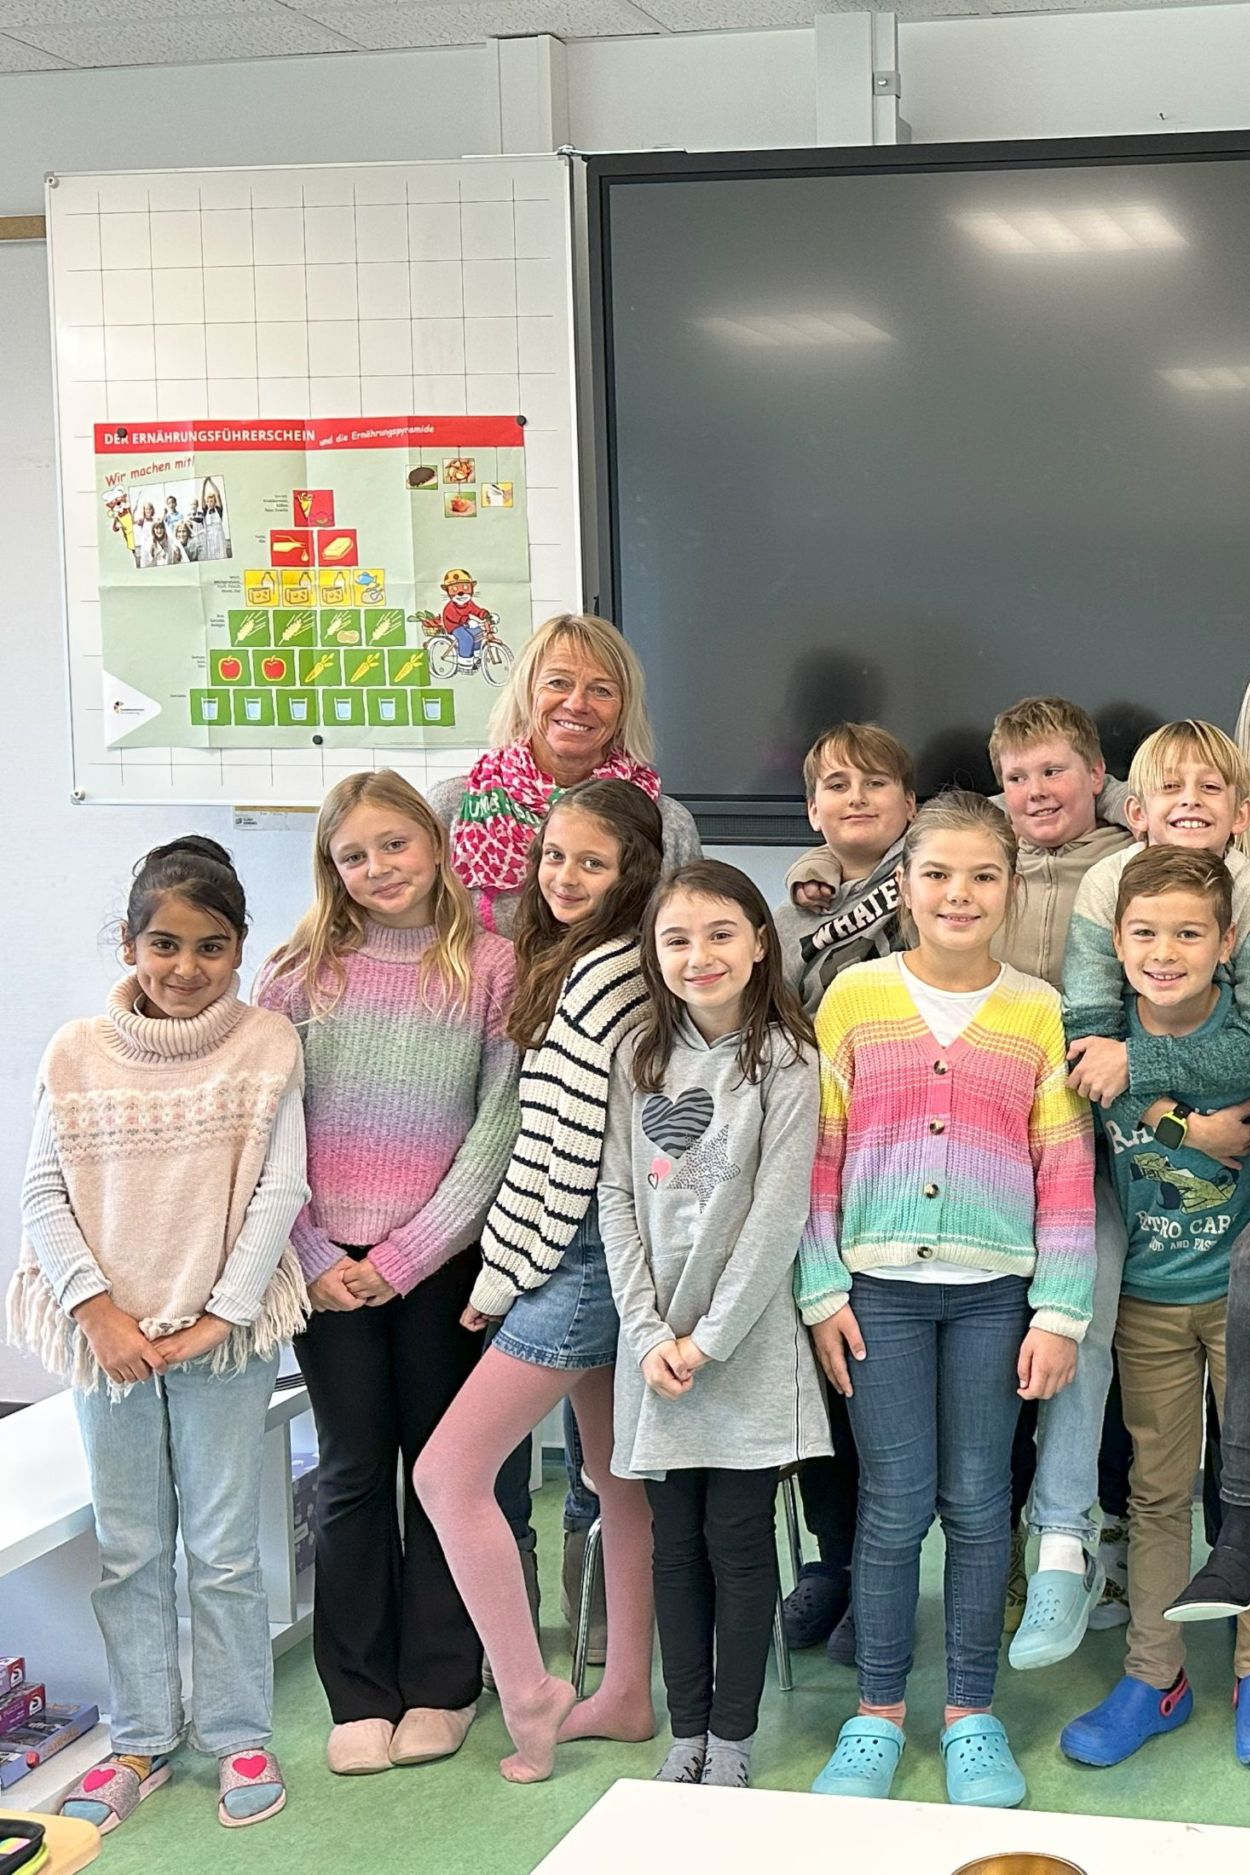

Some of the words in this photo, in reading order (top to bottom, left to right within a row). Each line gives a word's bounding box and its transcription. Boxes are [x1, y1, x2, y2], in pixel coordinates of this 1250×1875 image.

[104, 432, 129, 445] DER
[132, 428, 315, 445] ERNÄHRUNGSFÜHRERSCHEIN
[335, 434, 349, 443] die
[351, 425, 435, 441] Ernährungspyramide
[105, 472, 126, 487] Wir
[130, 461, 172, 479] machen
